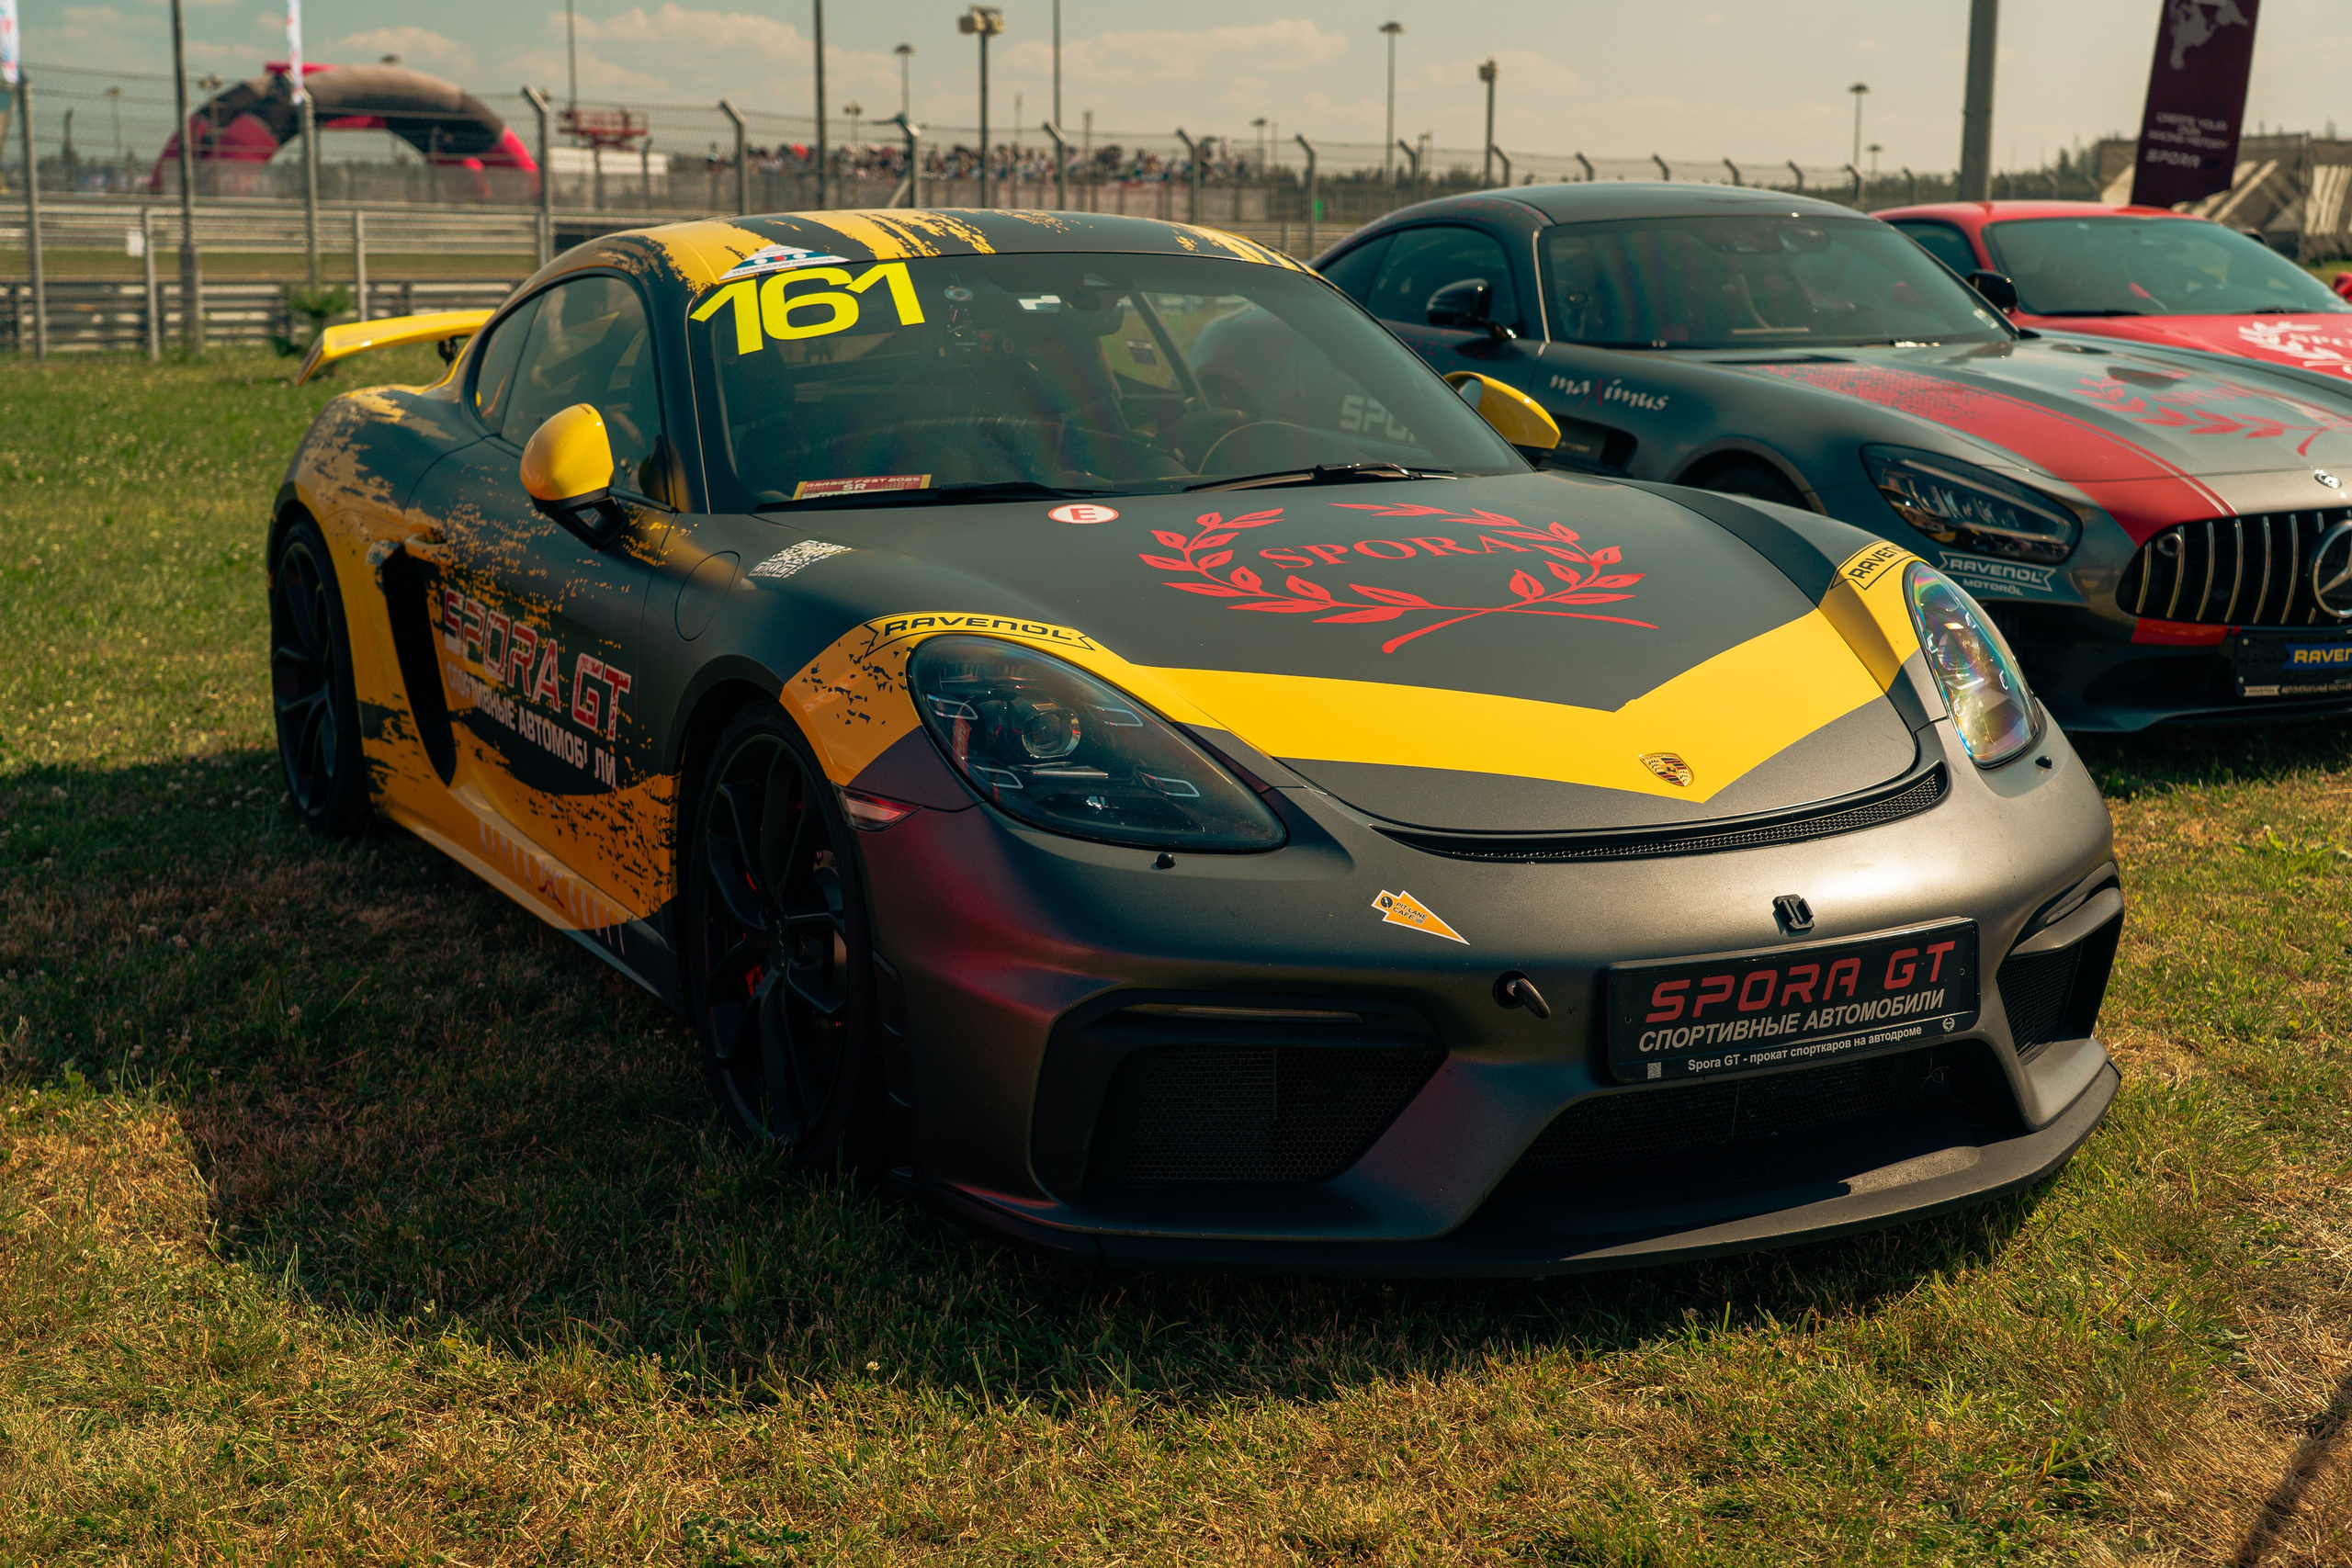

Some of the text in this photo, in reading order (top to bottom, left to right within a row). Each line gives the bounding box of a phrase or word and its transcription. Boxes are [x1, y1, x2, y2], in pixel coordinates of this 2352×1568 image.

[2145, 148, 2201, 169] SPORA
[689, 262, 925, 355] 161
[1340, 394, 1416, 443] SPO
[1069, 508, 1097, 520] E
[1259, 535, 1537, 570] SPORA
[1950, 558, 2041, 583] RAVENOL
[1962, 578, 2024, 596] MOTORÖL
[884, 616, 1072, 640] RAVENOL
[445, 587, 632, 742] SPORA GT
[447, 660, 516, 731] СПОРТИВНЫЕ
[1392, 907, 1415, 920] CAFE
[1396, 902, 1428, 920] PIT-LANE
[1645, 941, 1955, 1023] SPORA GT
[1639, 988, 1945, 1053] СПОРТИВНЫЕ АВТОМОБИЛИ
[1688, 1058, 1722, 1072] Spora
[1724, 1054, 1740, 1066] GT
[1749, 1049, 1789, 1065] прокат
[1790, 1038, 1851, 1057] спорткаров
[1853, 1035, 1866, 1047] на
[1868, 1025, 1922, 1044] автодроме
